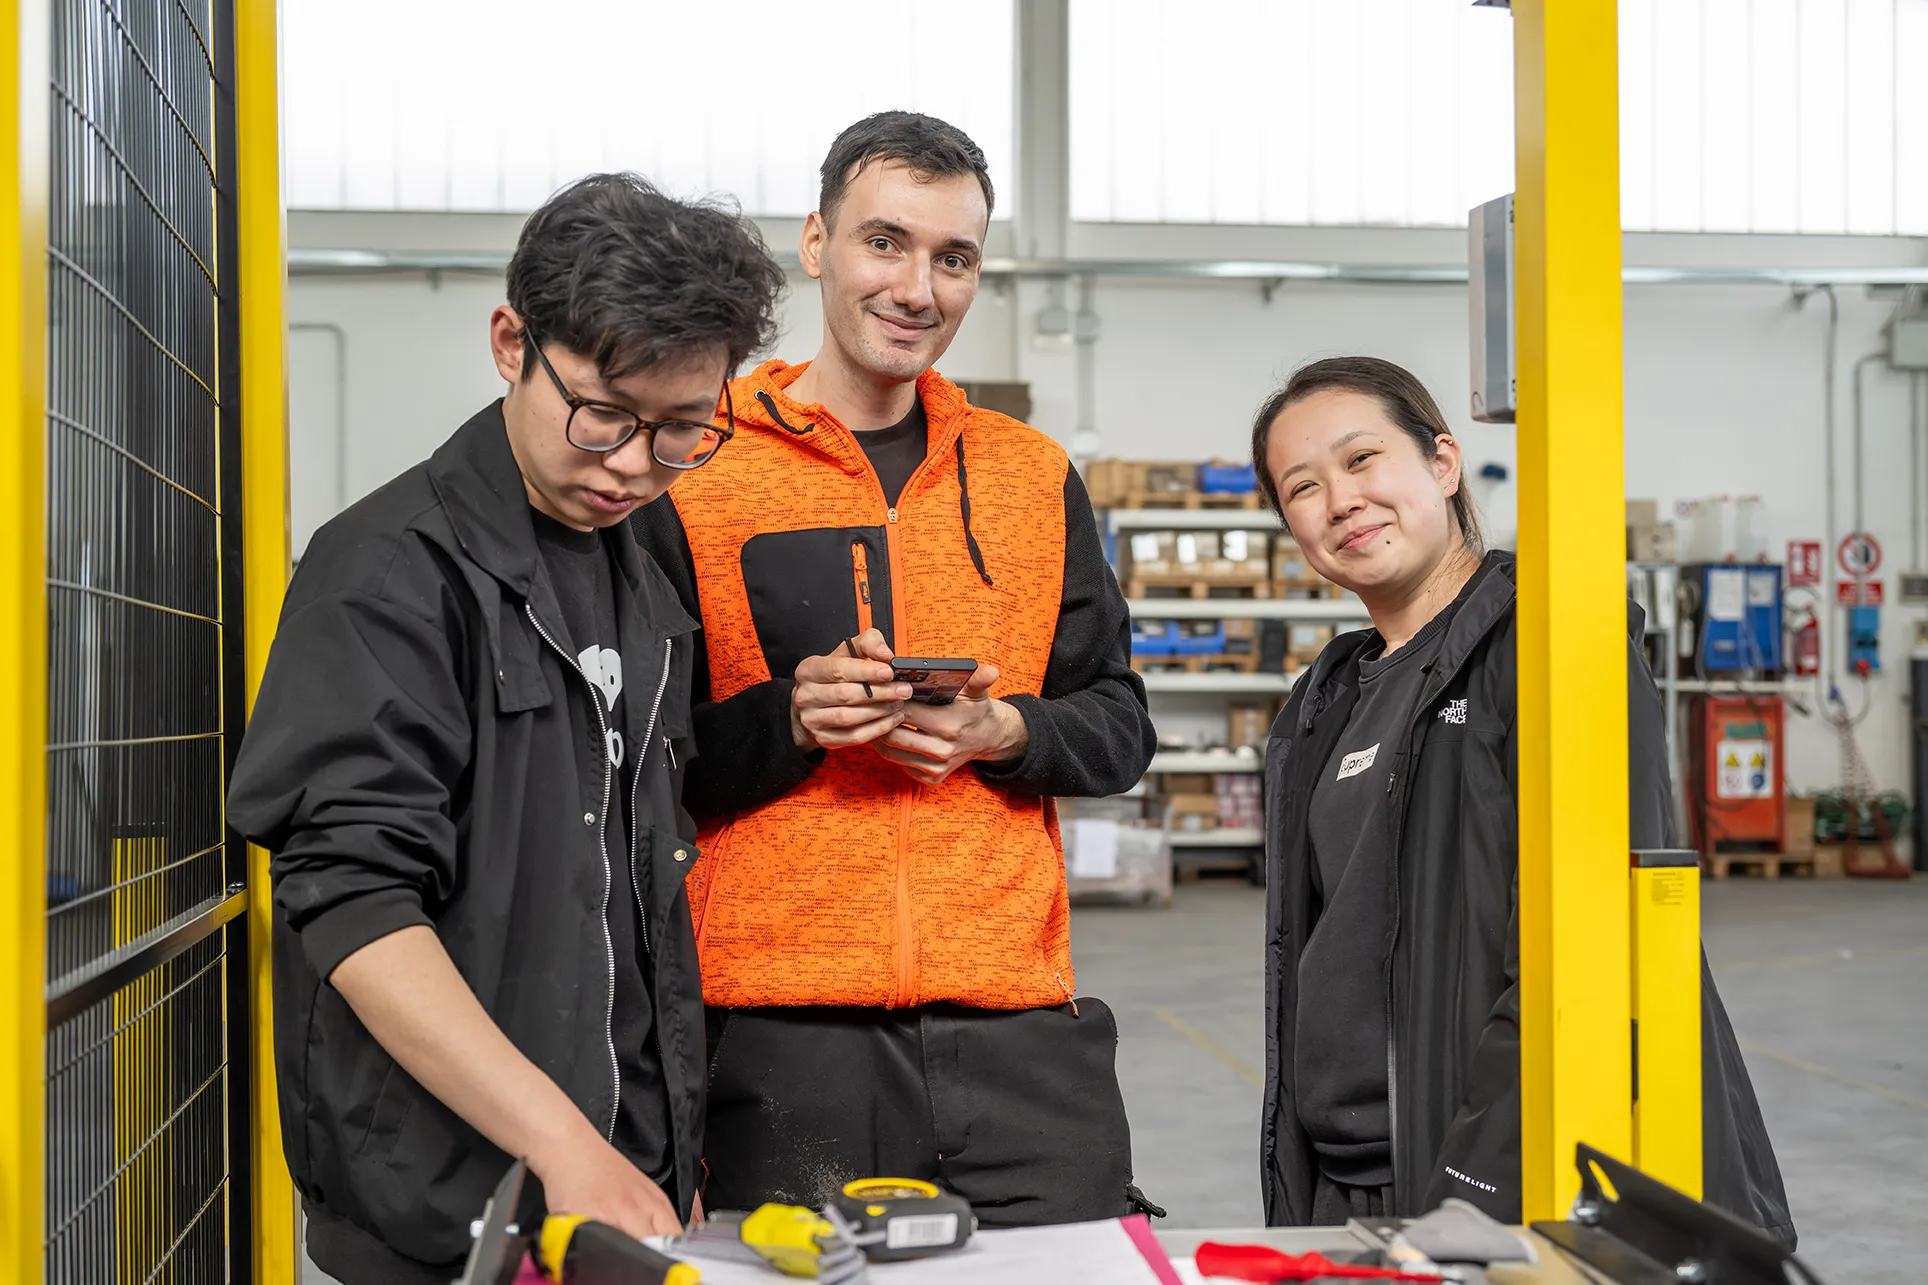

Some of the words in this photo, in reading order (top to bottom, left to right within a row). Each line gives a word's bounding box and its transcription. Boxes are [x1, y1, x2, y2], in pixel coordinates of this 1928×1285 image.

[1449, 698, 1467, 708] THE
[1437, 707, 1467, 718] NORTH
[1445, 715, 1466, 724] FACE
